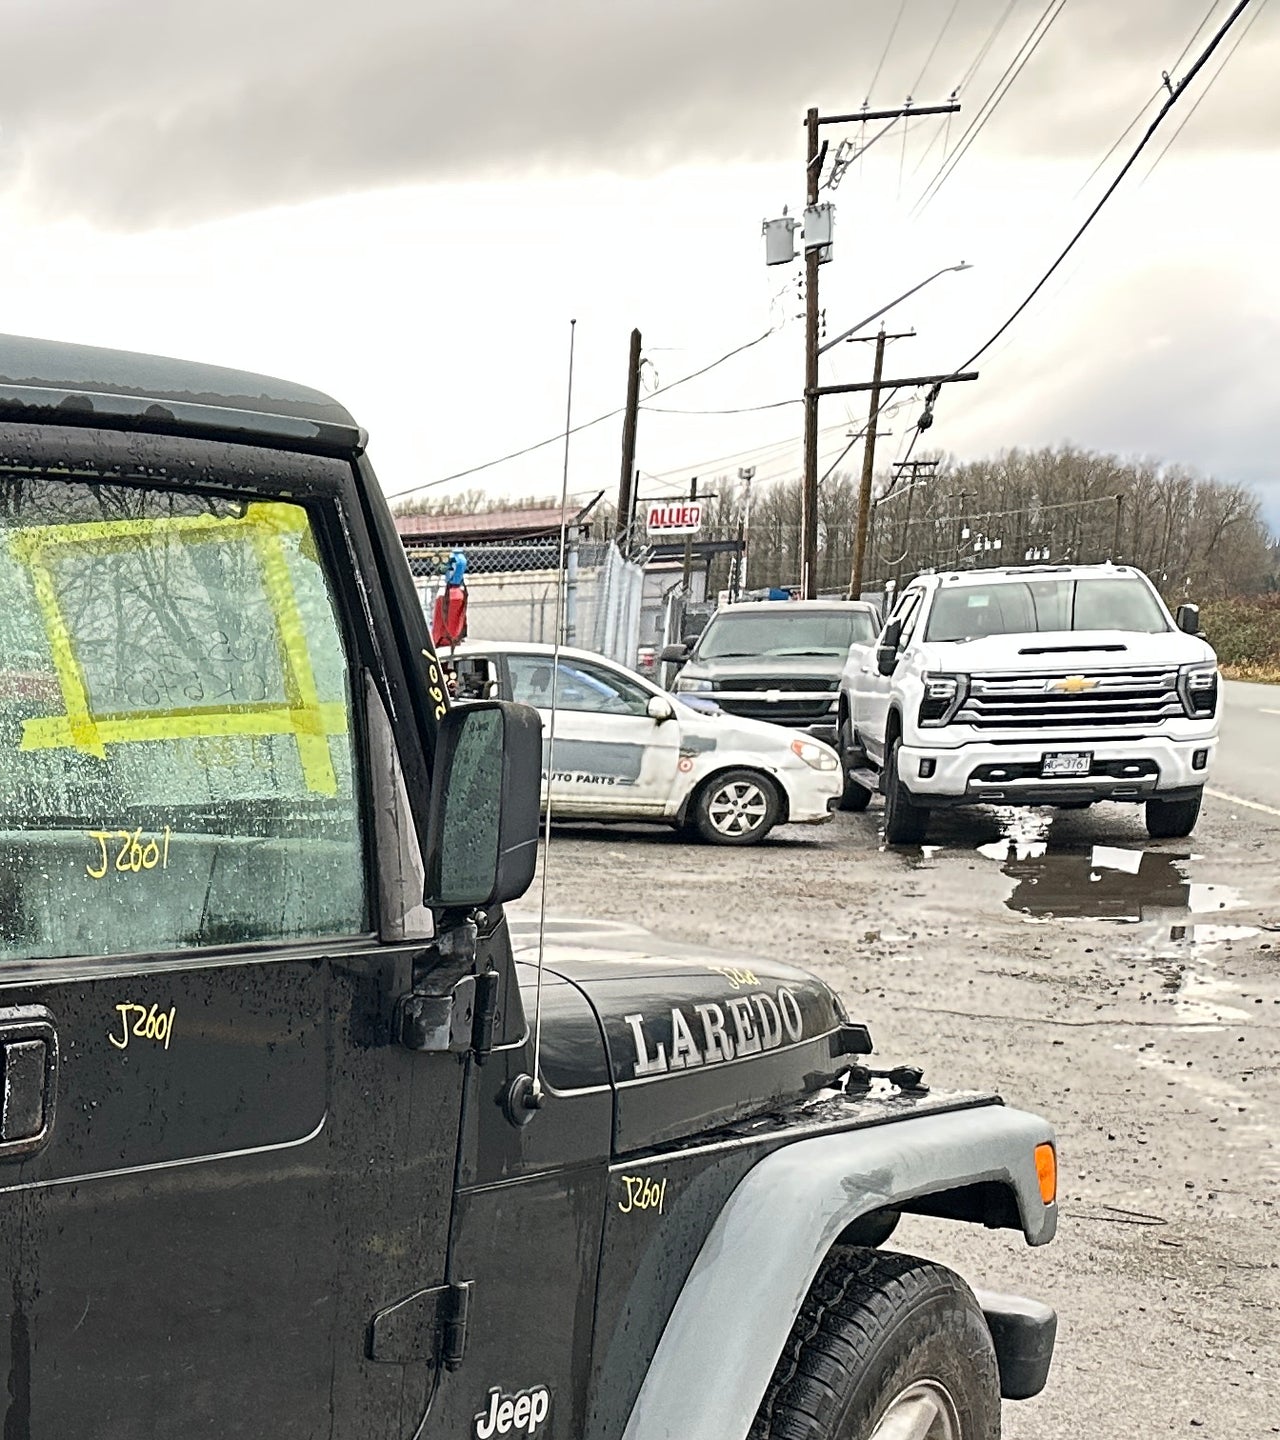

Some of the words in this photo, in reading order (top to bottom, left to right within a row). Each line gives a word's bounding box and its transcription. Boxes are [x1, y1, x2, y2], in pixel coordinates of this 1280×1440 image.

[576, 775, 616, 786] PARTS
[86, 825, 171, 879] J2601
[108, 1003, 177, 1051] J2601
[624, 985, 804, 1077] LAREDO
[618, 1175, 667, 1215] J2601
[474, 1386, 551, 1440] Jeep
